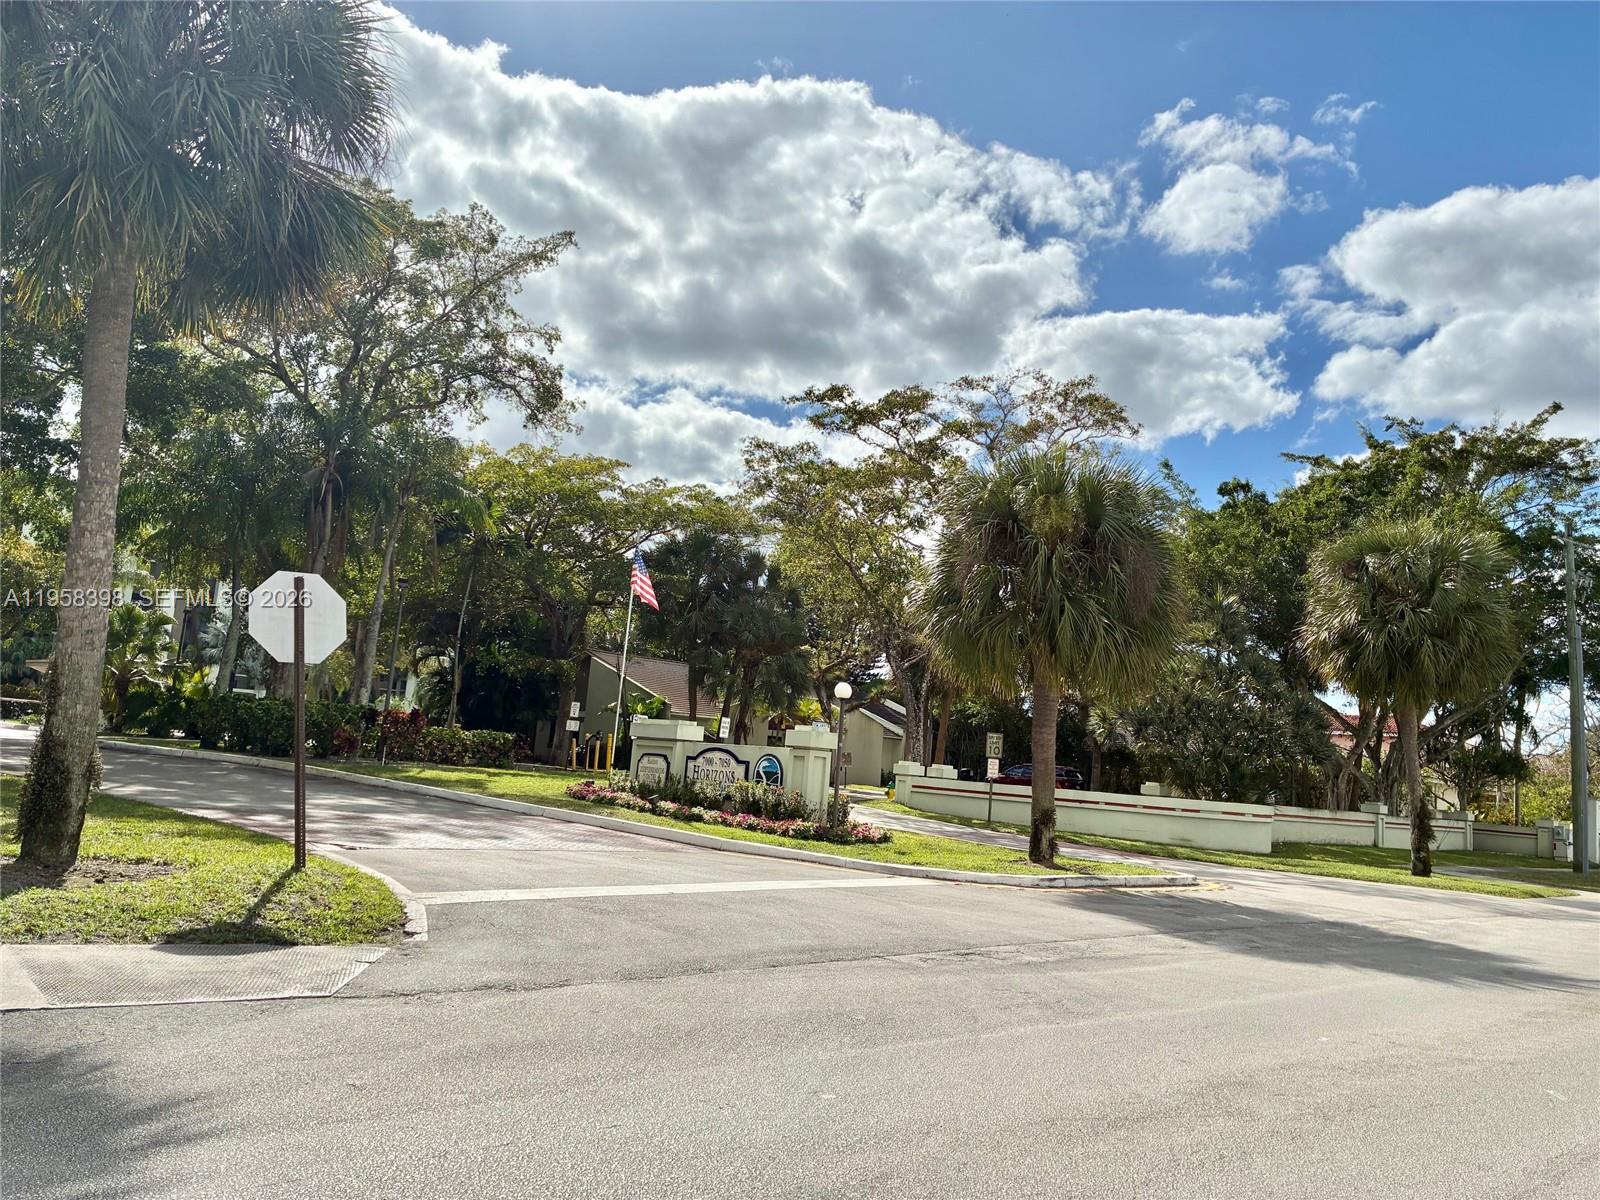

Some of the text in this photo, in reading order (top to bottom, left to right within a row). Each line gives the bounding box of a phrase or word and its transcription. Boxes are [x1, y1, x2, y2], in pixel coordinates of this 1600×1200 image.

[989, 746, 1000, 755] 10
[702, 756, 714, 767] 7000
[692, 765, 735, 784] HORIZONS
